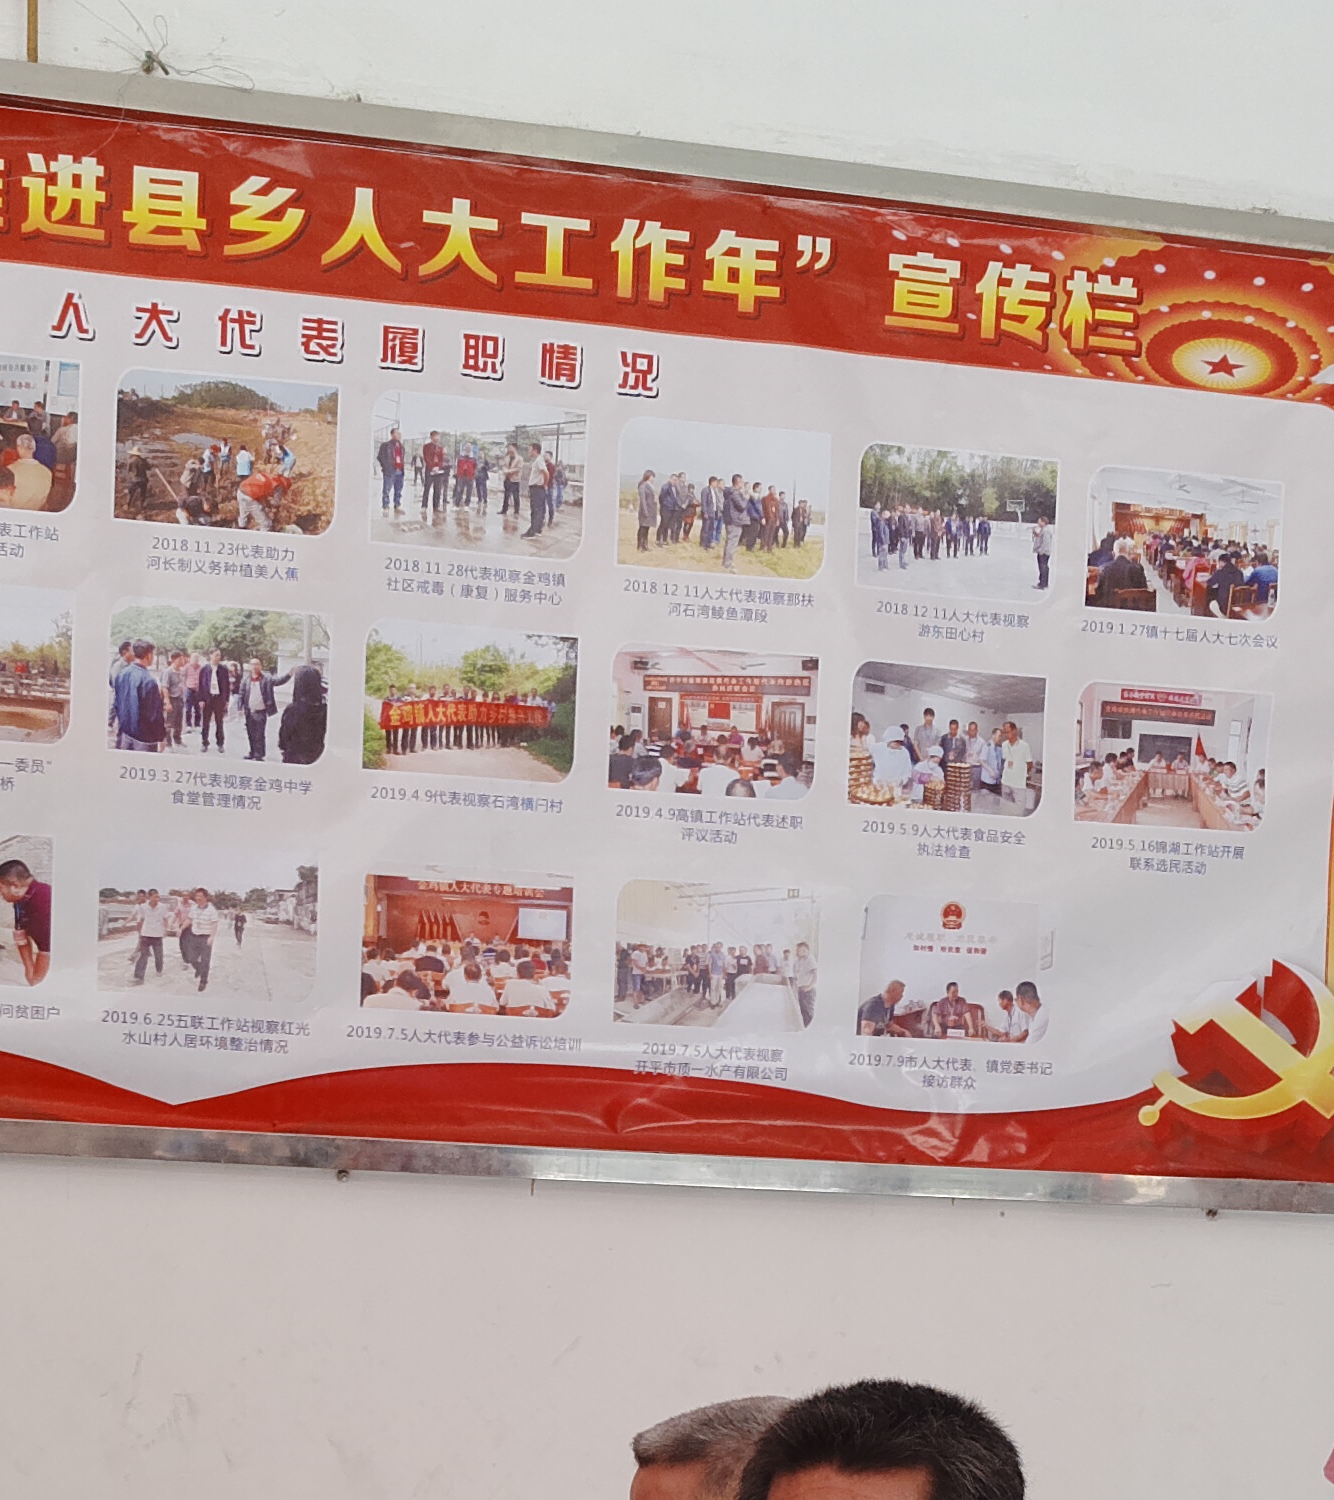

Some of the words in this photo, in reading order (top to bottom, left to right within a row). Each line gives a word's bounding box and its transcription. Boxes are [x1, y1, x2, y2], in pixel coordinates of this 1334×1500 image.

[884, 249, 1141, 358] 宣传栏
[49, 291, 661, 398] 人大代表履职情况
[146, 554, 299, 582] 河长制义务种植美人蕉
[918, 623, 984, 643] 游东田心村
[171, 789, 262, 811] 食堂管理情况
[680, 826, 743, 846] 评议活动
[916, 841, 971, 860] 执法检查
[1129, 855, 1208, 877] 联系选民活动
[122, 1030, 289, 1055] 水山村人居环境整治情况
[921, 1073, 977, 1092] 接访群众
